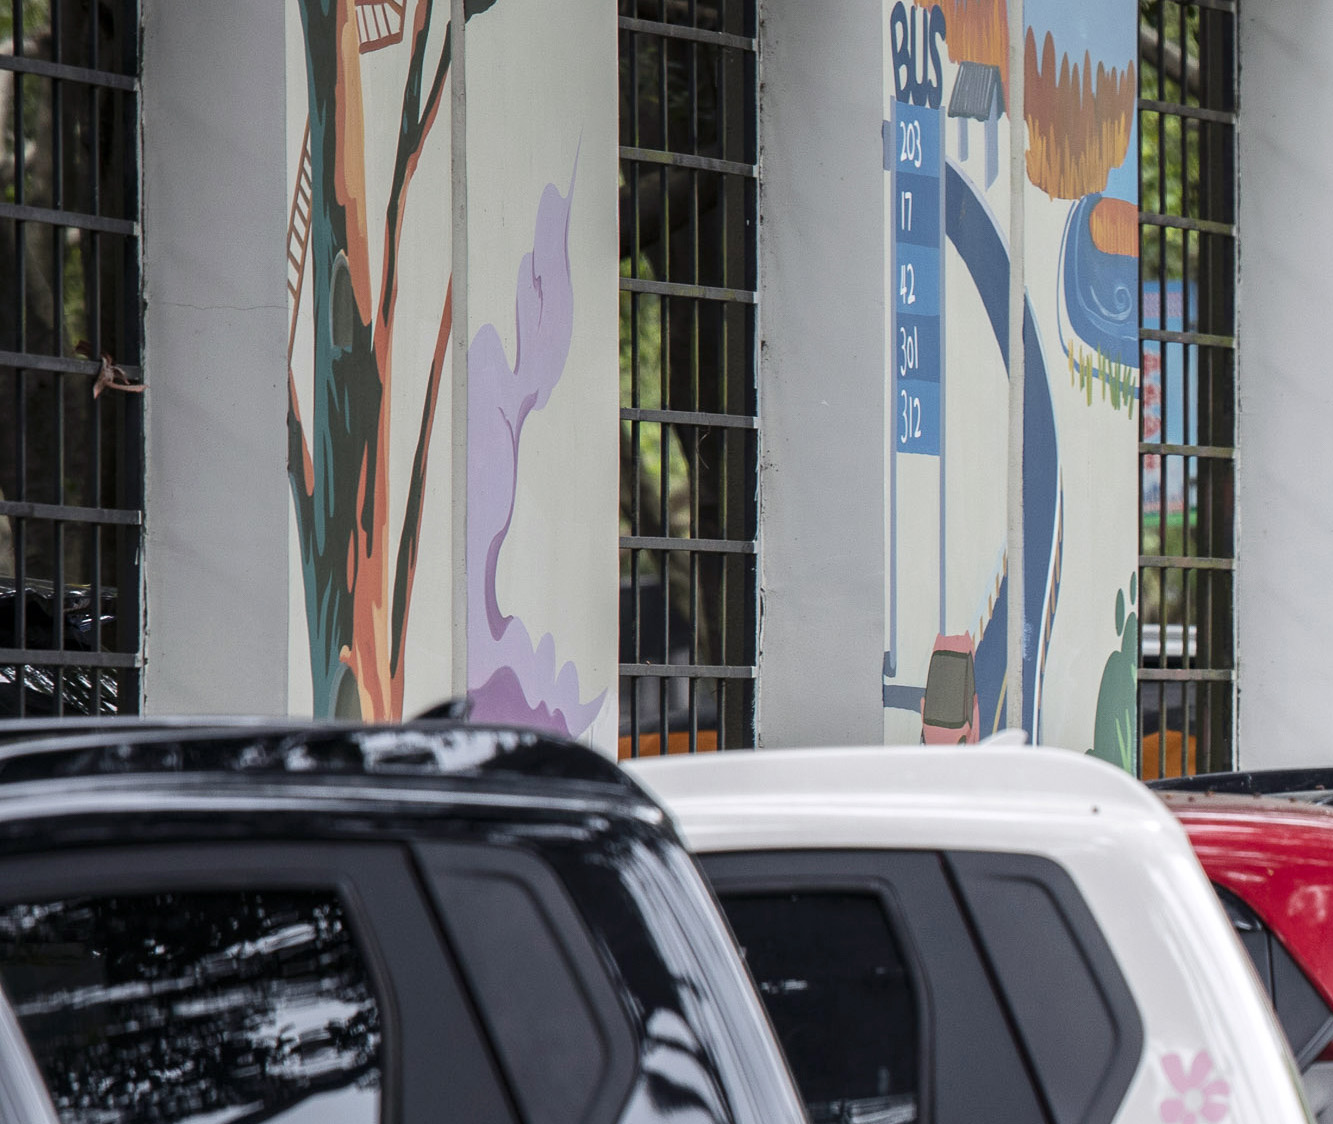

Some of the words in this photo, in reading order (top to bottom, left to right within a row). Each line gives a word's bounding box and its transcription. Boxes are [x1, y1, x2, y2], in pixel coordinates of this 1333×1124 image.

[890, 1, 947, 110] BUS
[900, 120, 922, 168] 203
[901, 191, 912, 231] 17
[900, 264, 916, 305] 42
[900, 326, 918, 376] 301
[900, 389, 922, 444] 312
